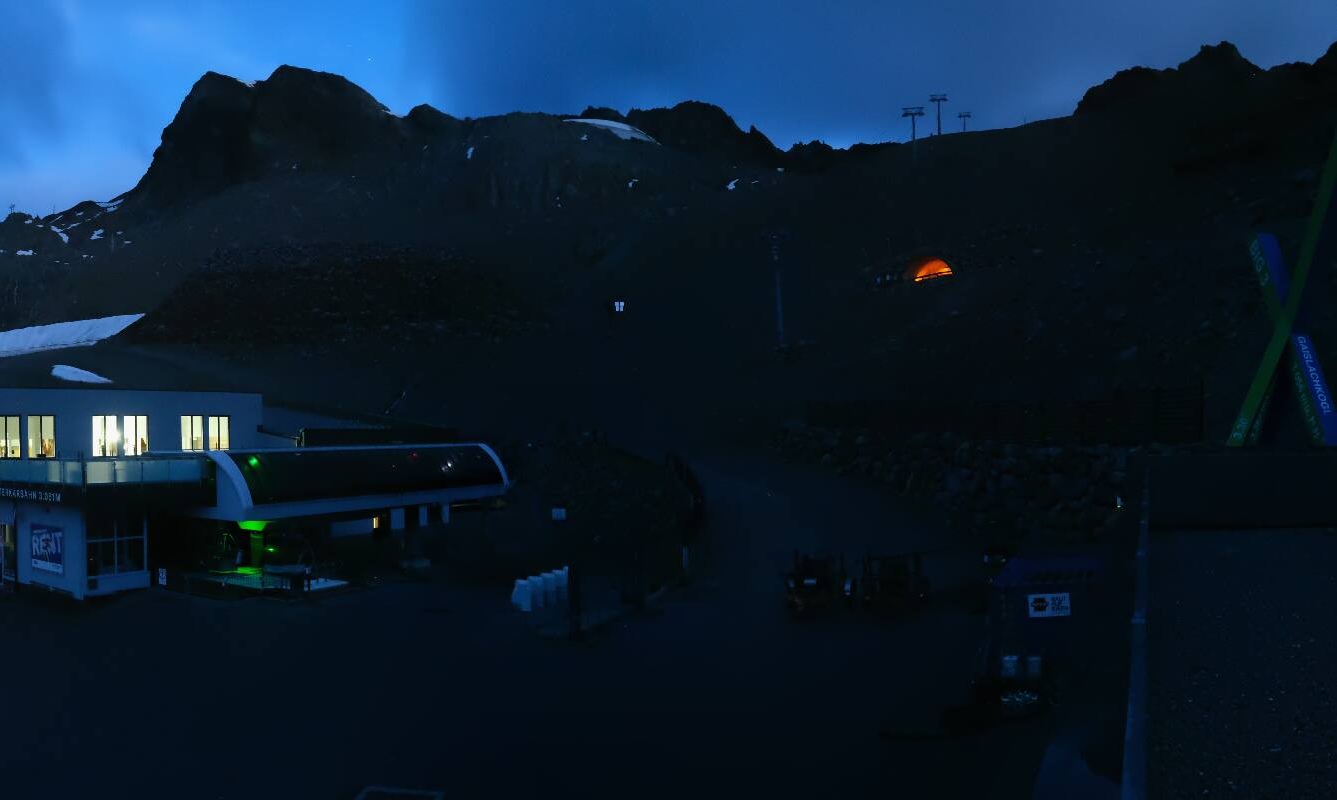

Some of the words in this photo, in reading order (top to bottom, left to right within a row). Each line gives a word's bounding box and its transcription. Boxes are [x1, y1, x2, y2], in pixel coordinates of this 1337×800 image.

[1248, 240, 1265, 273] BIG
[1297, 335, 1332, 416] GAISLACHKOGL
[31, 531, 63, 555] RENT
